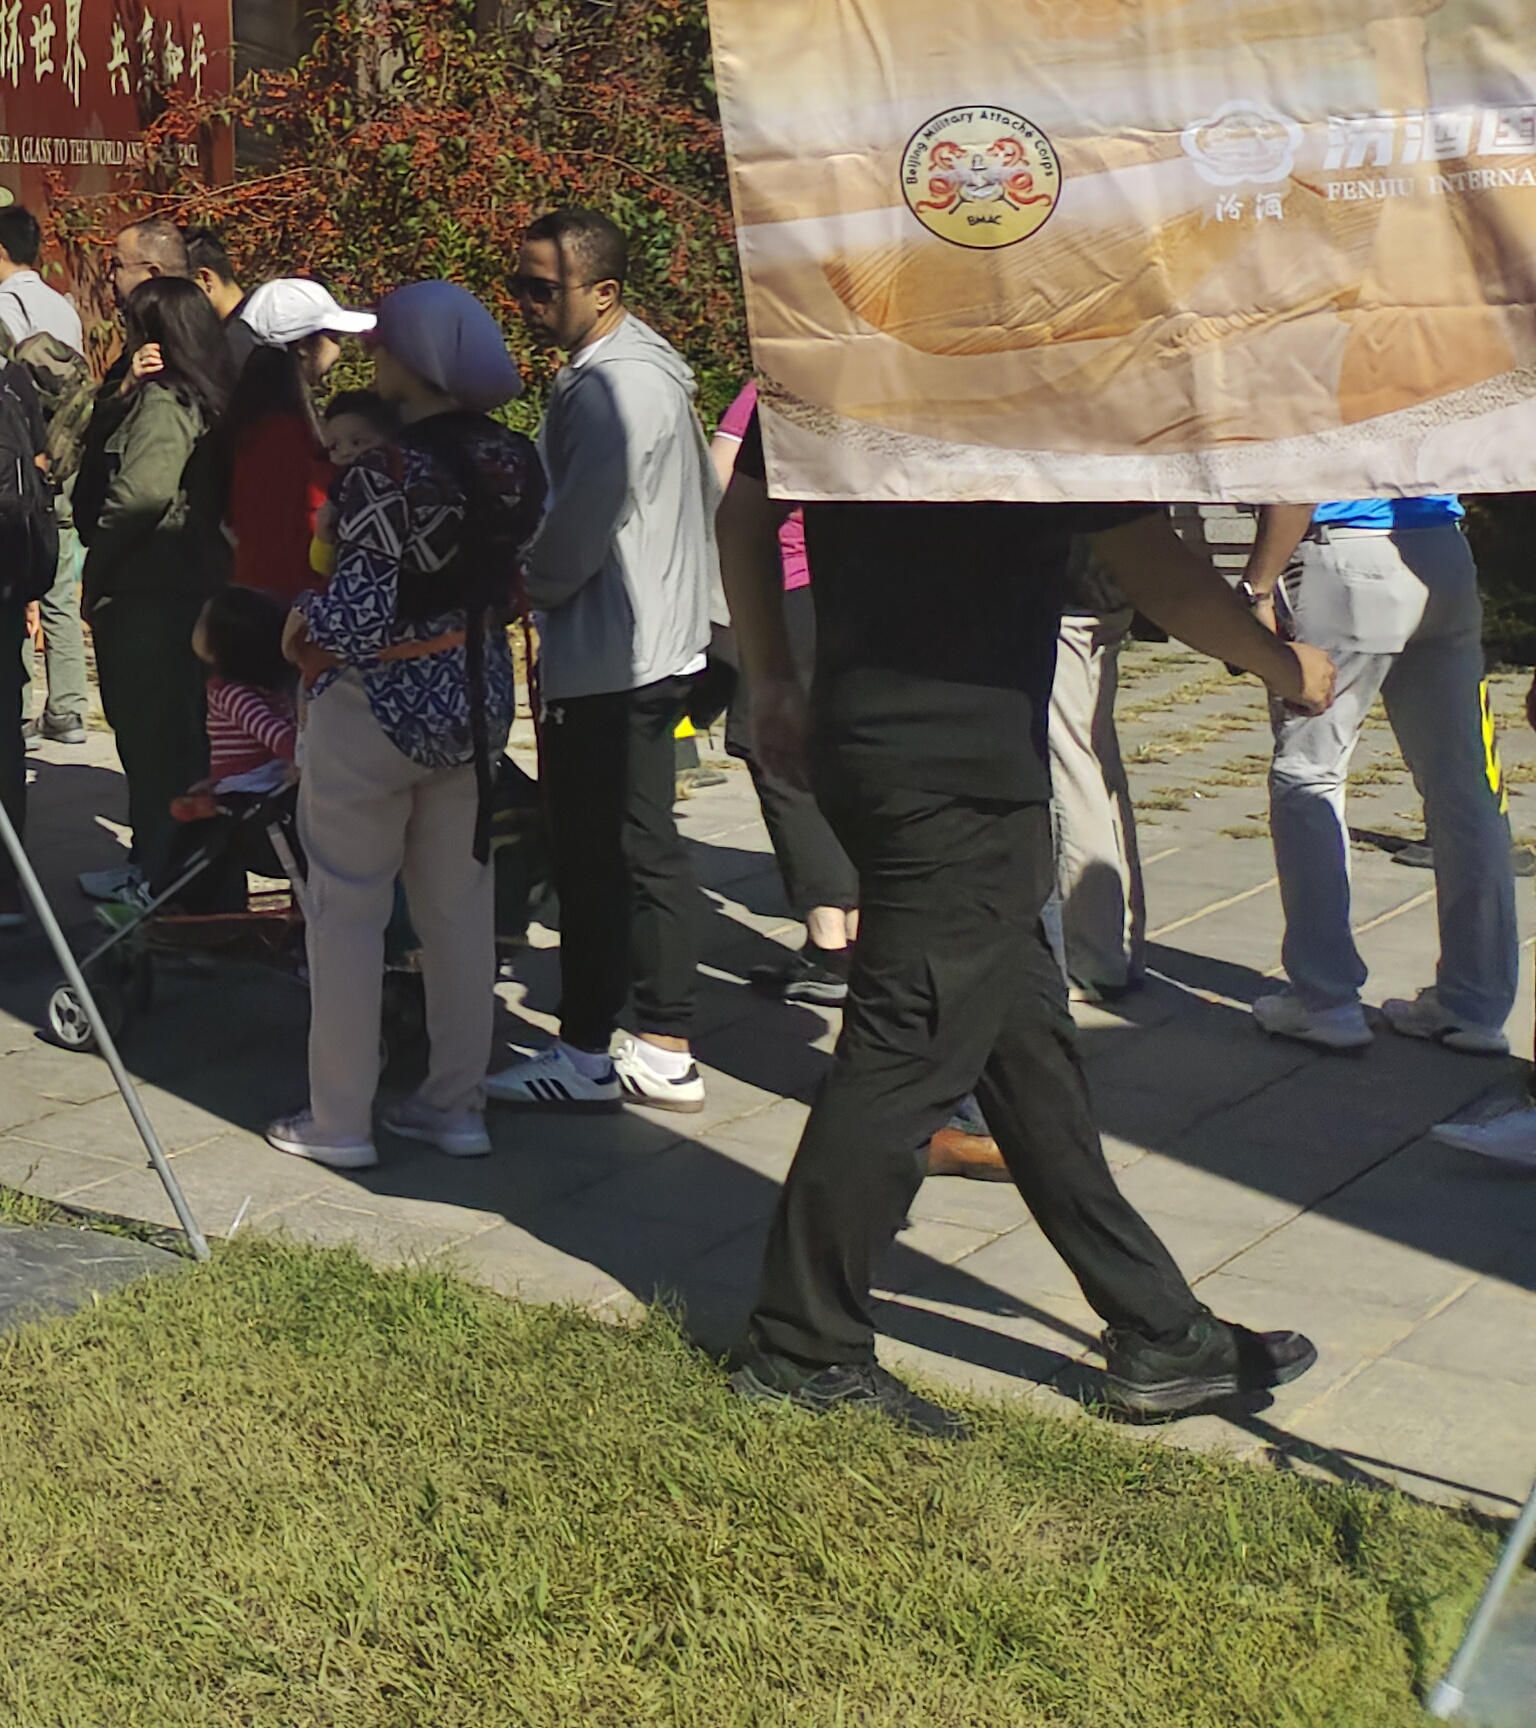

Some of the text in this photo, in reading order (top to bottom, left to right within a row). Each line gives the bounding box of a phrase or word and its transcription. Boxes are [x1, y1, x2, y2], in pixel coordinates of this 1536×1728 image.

[13, 137, 20, 163] A
[22, 136, 51, 164] GLASS
[53, 139, 68, 164] TO
[69, 139, 89, 165] THE
[91, 140, 125, 165] WORLD
[906, 142, 929, 184] Beijing
[923, 111, 974, 141] Military
[1034, 140, 1054, 177] Corps
[1328, 168, 1536, 202] FENJIU INTERNA
[967, 215, 1003, 226] BMAC
